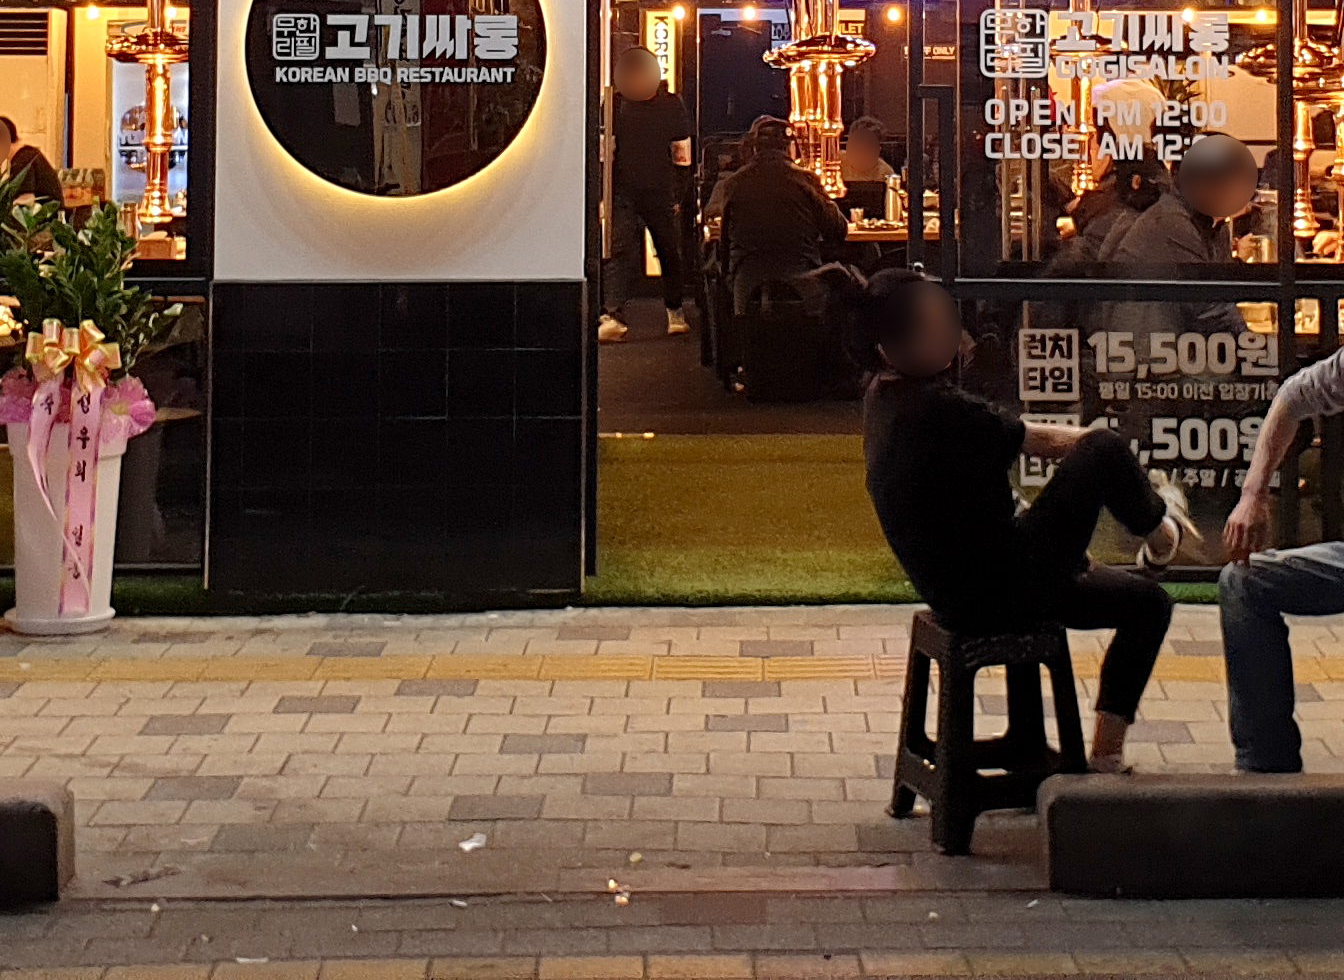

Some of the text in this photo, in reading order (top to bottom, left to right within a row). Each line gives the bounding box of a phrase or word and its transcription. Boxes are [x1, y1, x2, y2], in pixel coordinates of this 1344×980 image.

[324, 13, 519, 61] 고기싸롱
[1056, 10, 1229, 53] 고기싸롱
[275, 66, 516, 86] KOREAN BBQ RESTAURANT
[1056, 55, 1229, 81] GOGISALON
[1097, 99, 1142, 127] PM
[1155, 98, 1228, 128] 12:00
[1099, 133, 1144, 161] AM
[1022, 333, 1074, 361] 런치
[1087, 331, 1280, 379] 15,500원
[1023, 365, 1074, 394] 타임
[1099, 382, 1131, 401] 평일
[1135, 382, 1179, 400] 15:00
